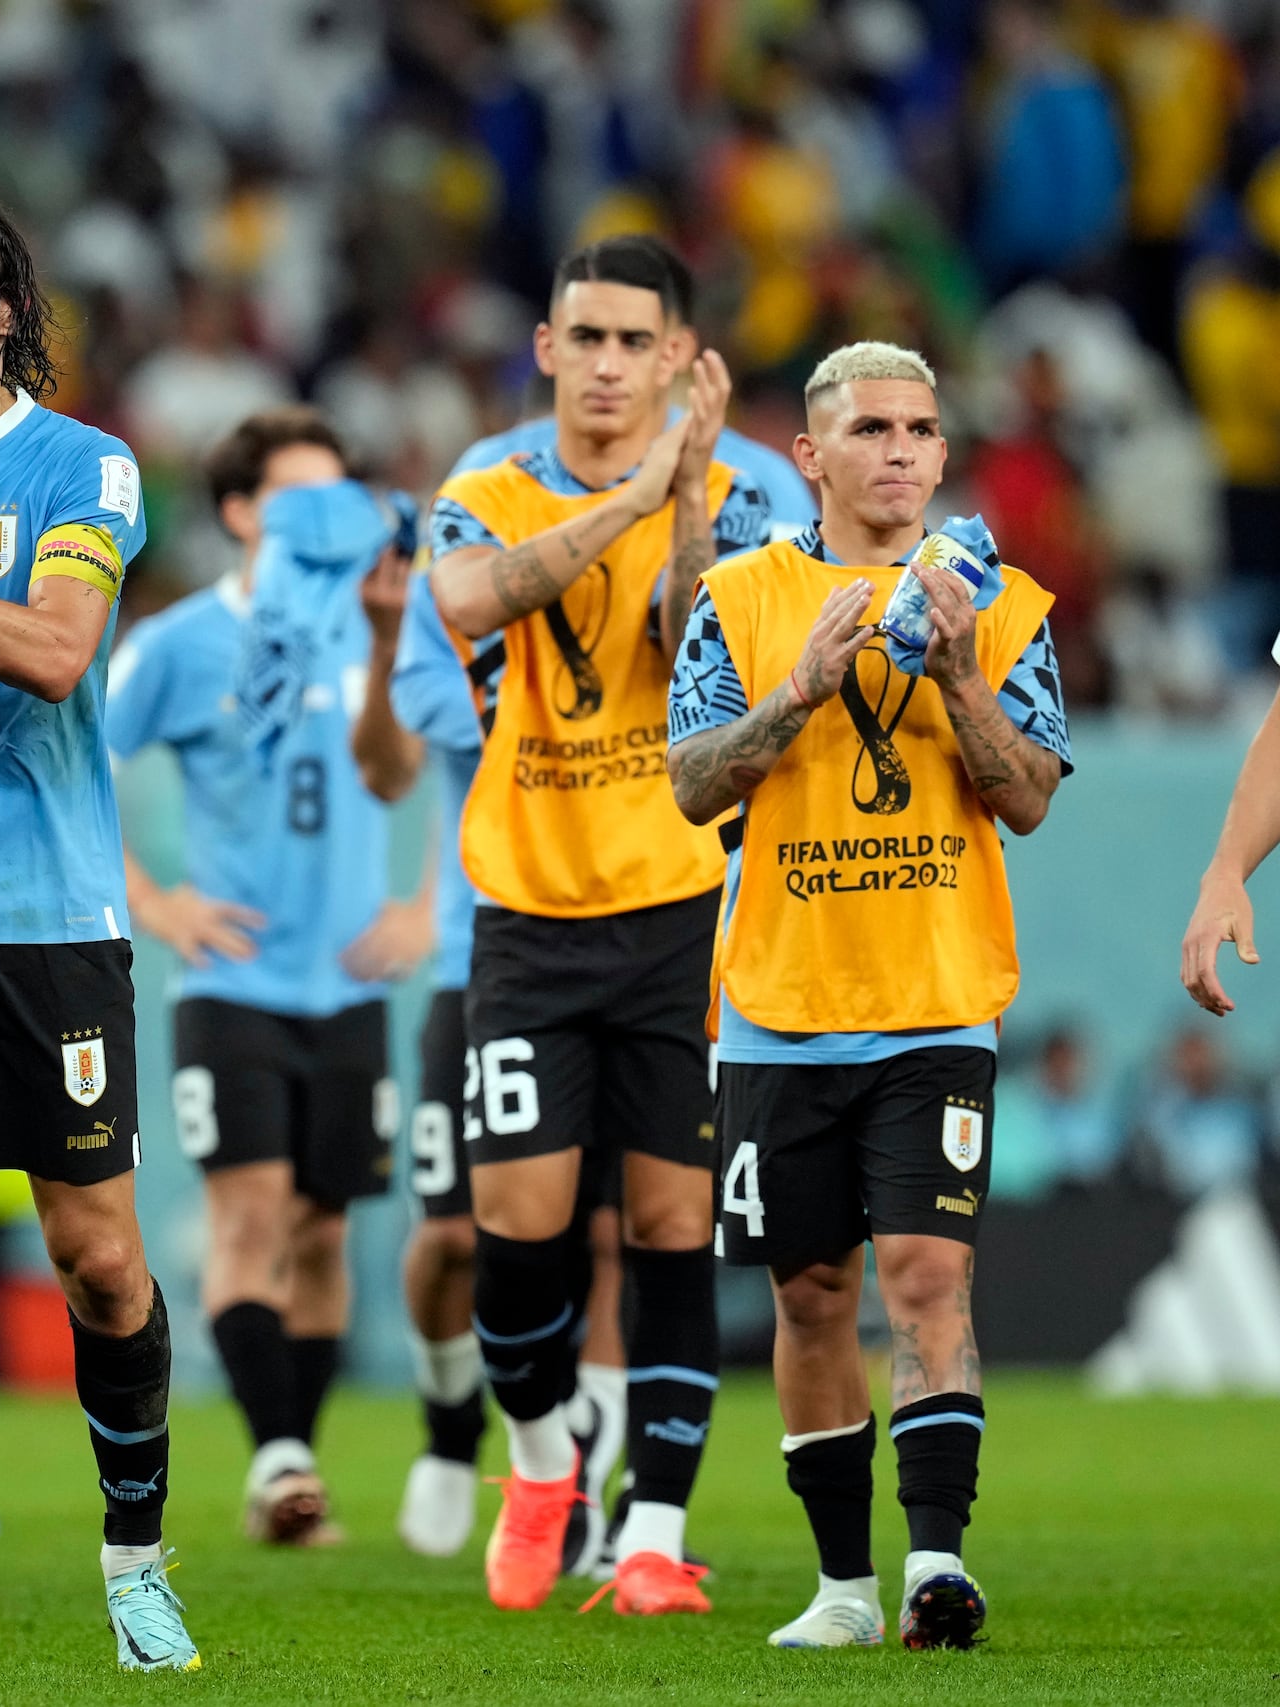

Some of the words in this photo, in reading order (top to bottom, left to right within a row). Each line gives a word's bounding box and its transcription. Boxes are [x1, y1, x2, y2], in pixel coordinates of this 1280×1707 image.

[38, 550, 117, 584] CHILDREN
[515, 752, 665, 791] Qatar2022
[286, 755, 329, 838] 8
[777, 841, 828, 865] FIFA
[832, 835, 934, 861] WORLD
[940, 834, 966, 858] CUP
[786, 862, 958, 902] Qatar2022
[172, 1064, 219, 1158] 8
[66, 1132, 108, 1150] PUMA
[412, 1101, 456, 1197] 9
[723, 1140, 765, 1237] 4
[935, 1195, 974, 1216] PUMA
[103, 1478, 148, 1502] PUMA
